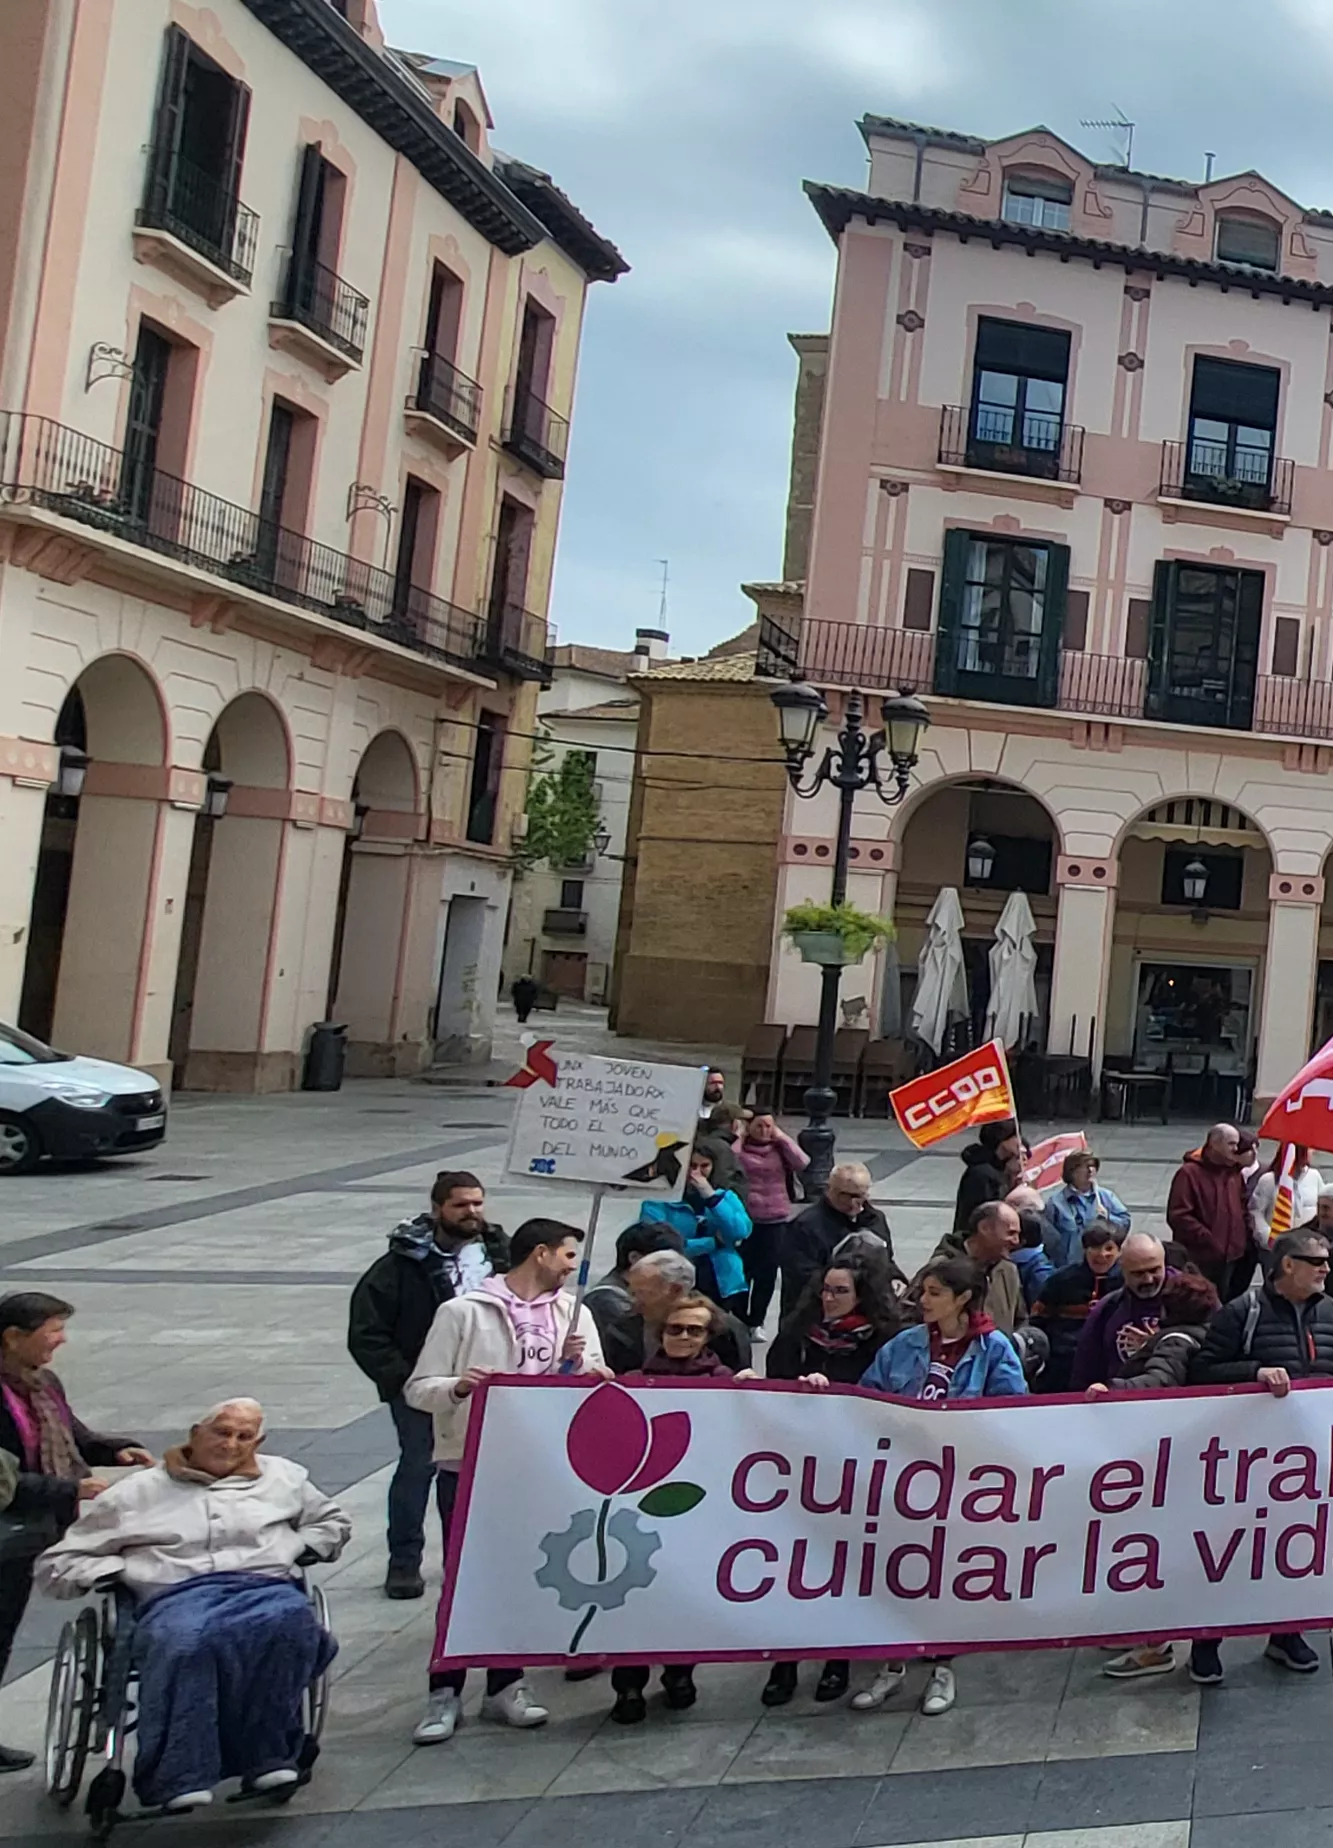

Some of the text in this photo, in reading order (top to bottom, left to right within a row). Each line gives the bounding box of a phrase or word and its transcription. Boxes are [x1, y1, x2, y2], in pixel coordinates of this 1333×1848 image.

[604, 1062, 653, 1081] JOVEN
[556, 1076, 666, 1100] TRABAJADORX
[904, 1066, 1001, 1130] CCOO
[539, 1095, 661, 1121] VALE MÁS QUE
[540, 1114, 658, 1138] TODO EL ORO
[541, 1141, 639, 1160] DEL MUNDO
[730, 1437, 1066, 1524] cuidar
[1088, 1436, 1172, 1514] el
[716, 1522, 1058, 1602] cuidar
[1082, 1519, 1165, 1595] la
